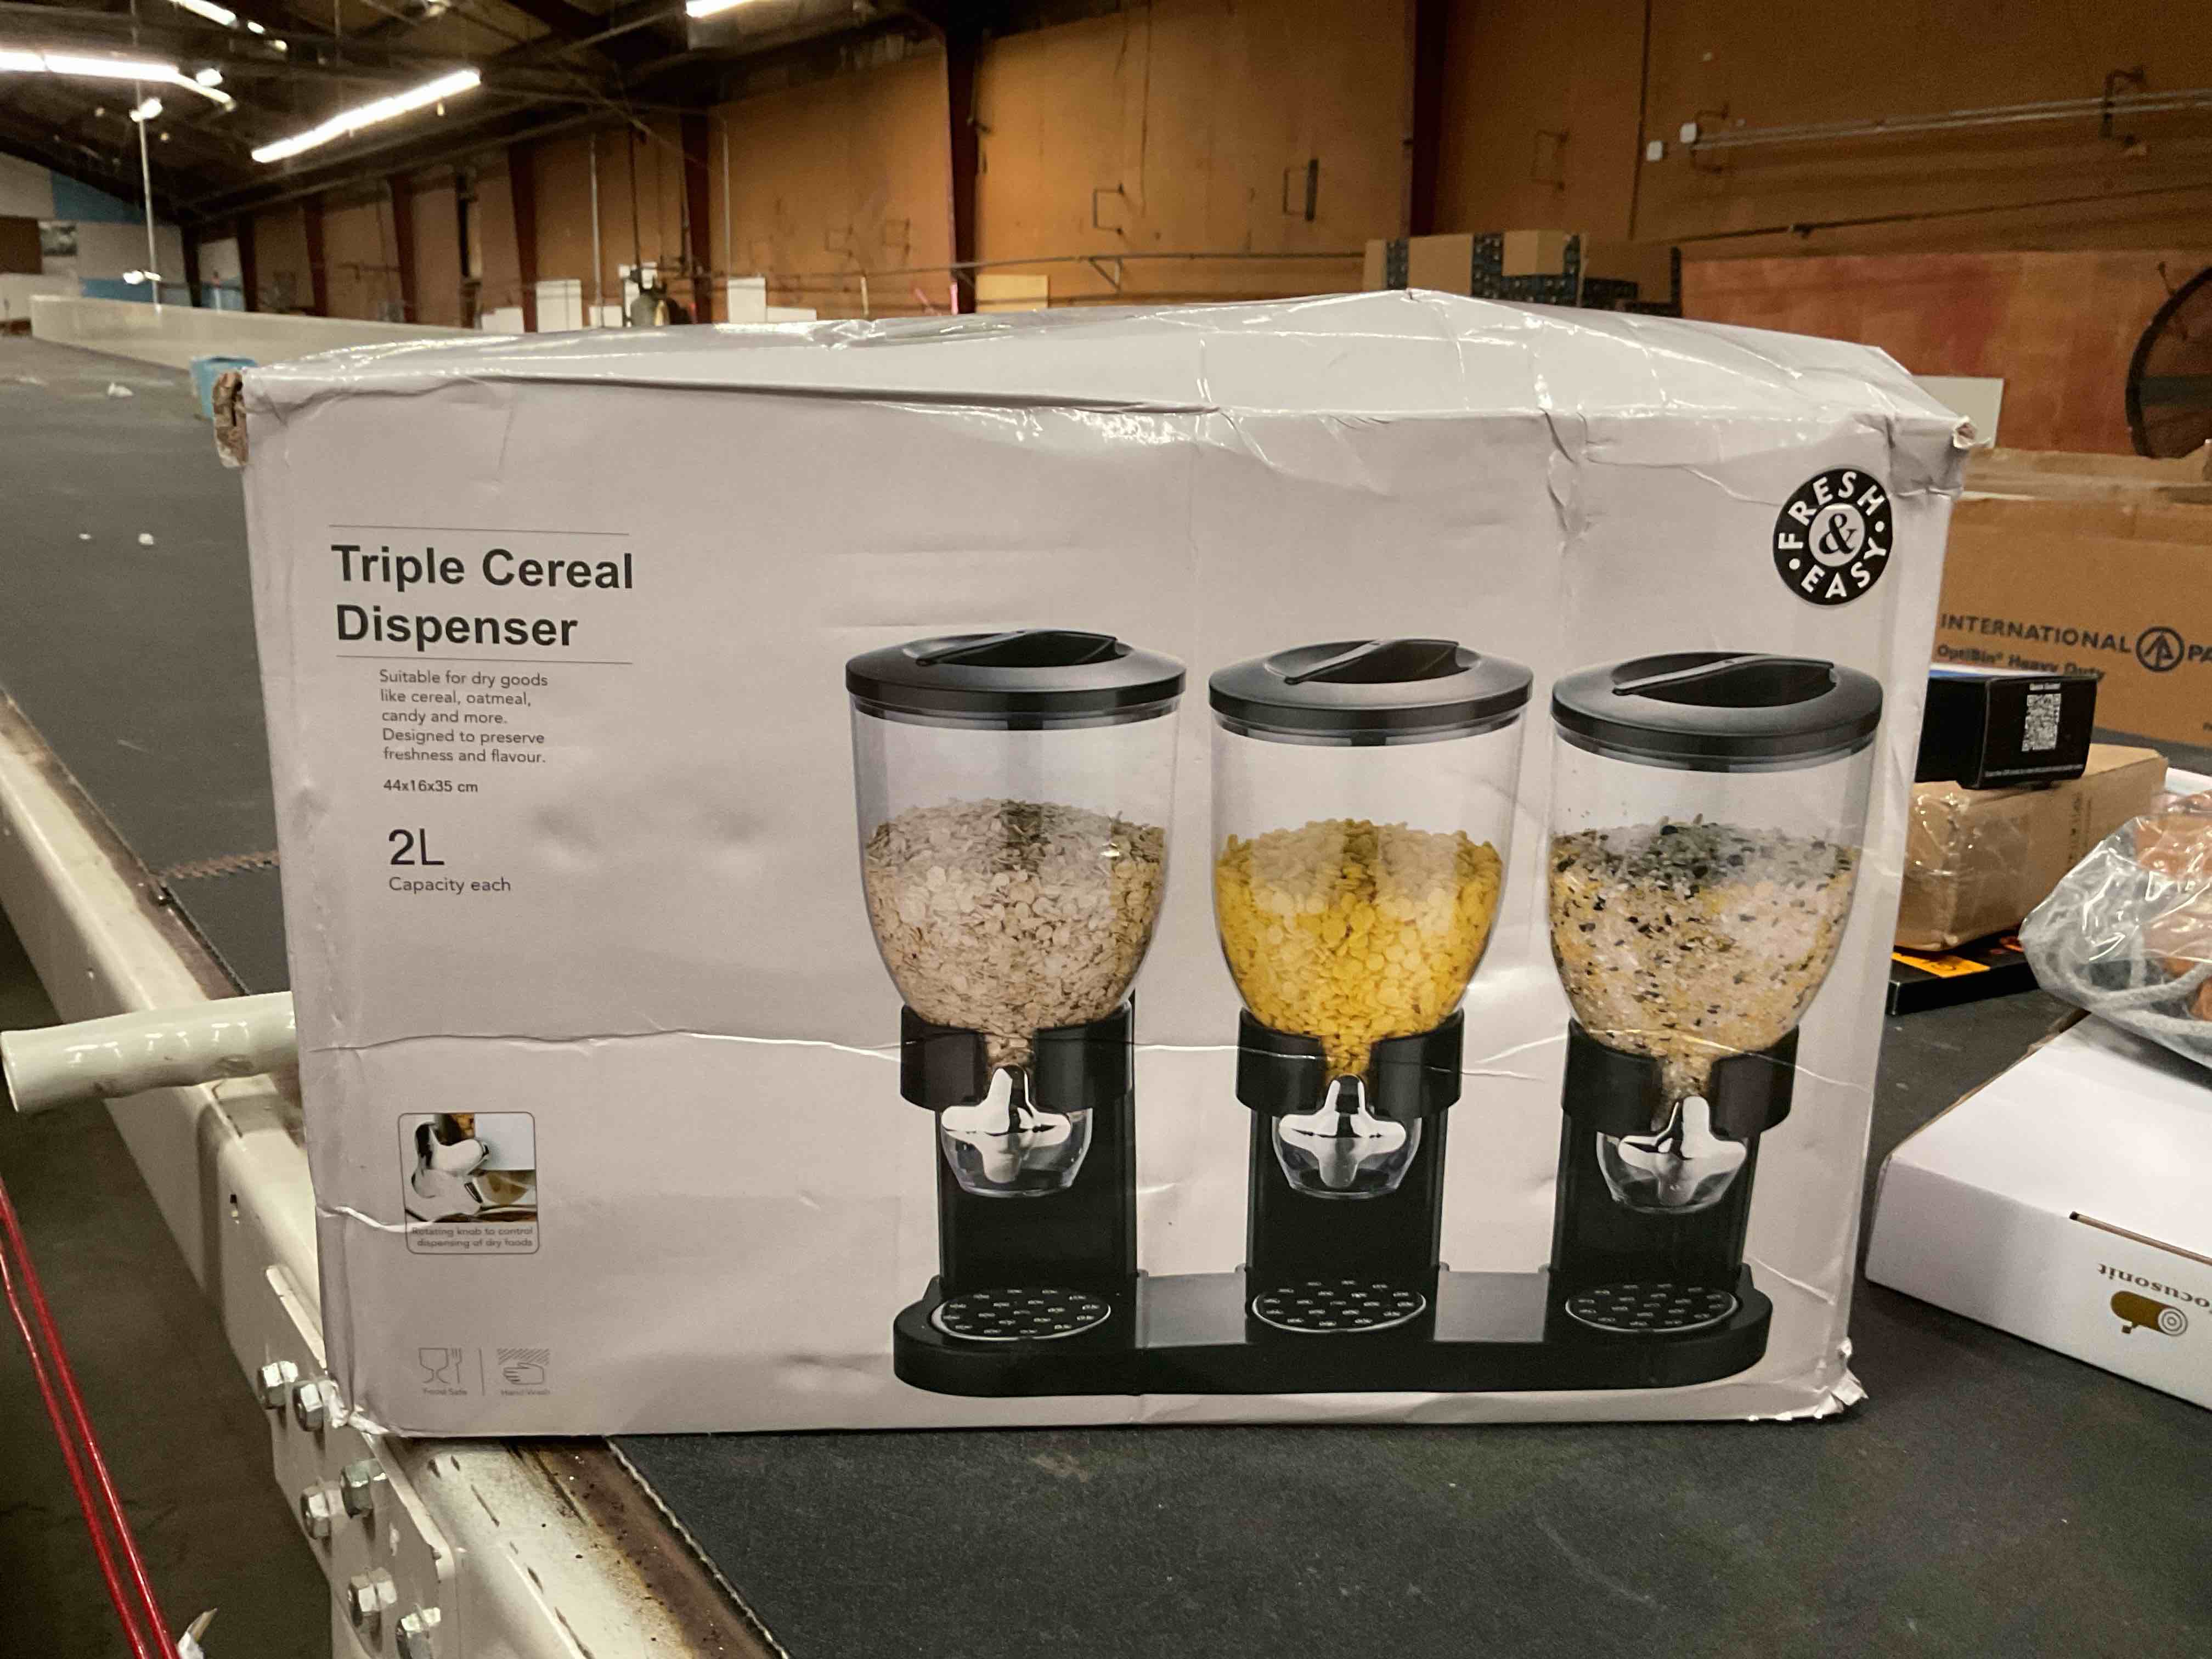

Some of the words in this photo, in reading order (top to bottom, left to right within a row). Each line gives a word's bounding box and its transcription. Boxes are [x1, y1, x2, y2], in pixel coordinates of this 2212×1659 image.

[1778, 471, 1885, 550] FRESH
[1819, 513, 1858, 555] &
[331, 544, 465, 592] Triple
[482, 549, 633, 589] Cereal
[1801, 537, 1887, 599] EASY
[336, 604, 578, 652] Dispenser
[1940, 614, 2131, 653] INTERNATIONAL
[380, 669, 440, 684] Suitable
[445, 670, 466, 684] for
[472, 672, 495, 688] dry
[500, 673, 548, 689] goods
[380, 689, 406, 702] like
[412, 690, 461, 705] cereal,
[466, 692, 531, 707] oatmeal,
[382, 709, 426, 725] candy
[431, 710, 459, 723] and
[465, 713, 507, 724] more.
[382, 728, 454, 745] Designed
[460, 731, 475, 742] to
[481, 732, 545, 746] preserve
[383, 747, 454, 761] freshness
[459, 749, 486, 761] and
[492, 749, 546, 763] flavour.
[383, 780, 453, 792] 44x16x35
[458, 783, 478, 793] cm
[388, 828, 445, 866] 2L
[389, 877, 465, 895] Capacity
[470, 878, 511, 892] each
[412, 1227, 454, 1237] Rotating
[417, 1238, 470, 1249] dispensing
[486, 1239, 501, 1248] dry
[2097, 1263, 2212, 1314] ocusonit
